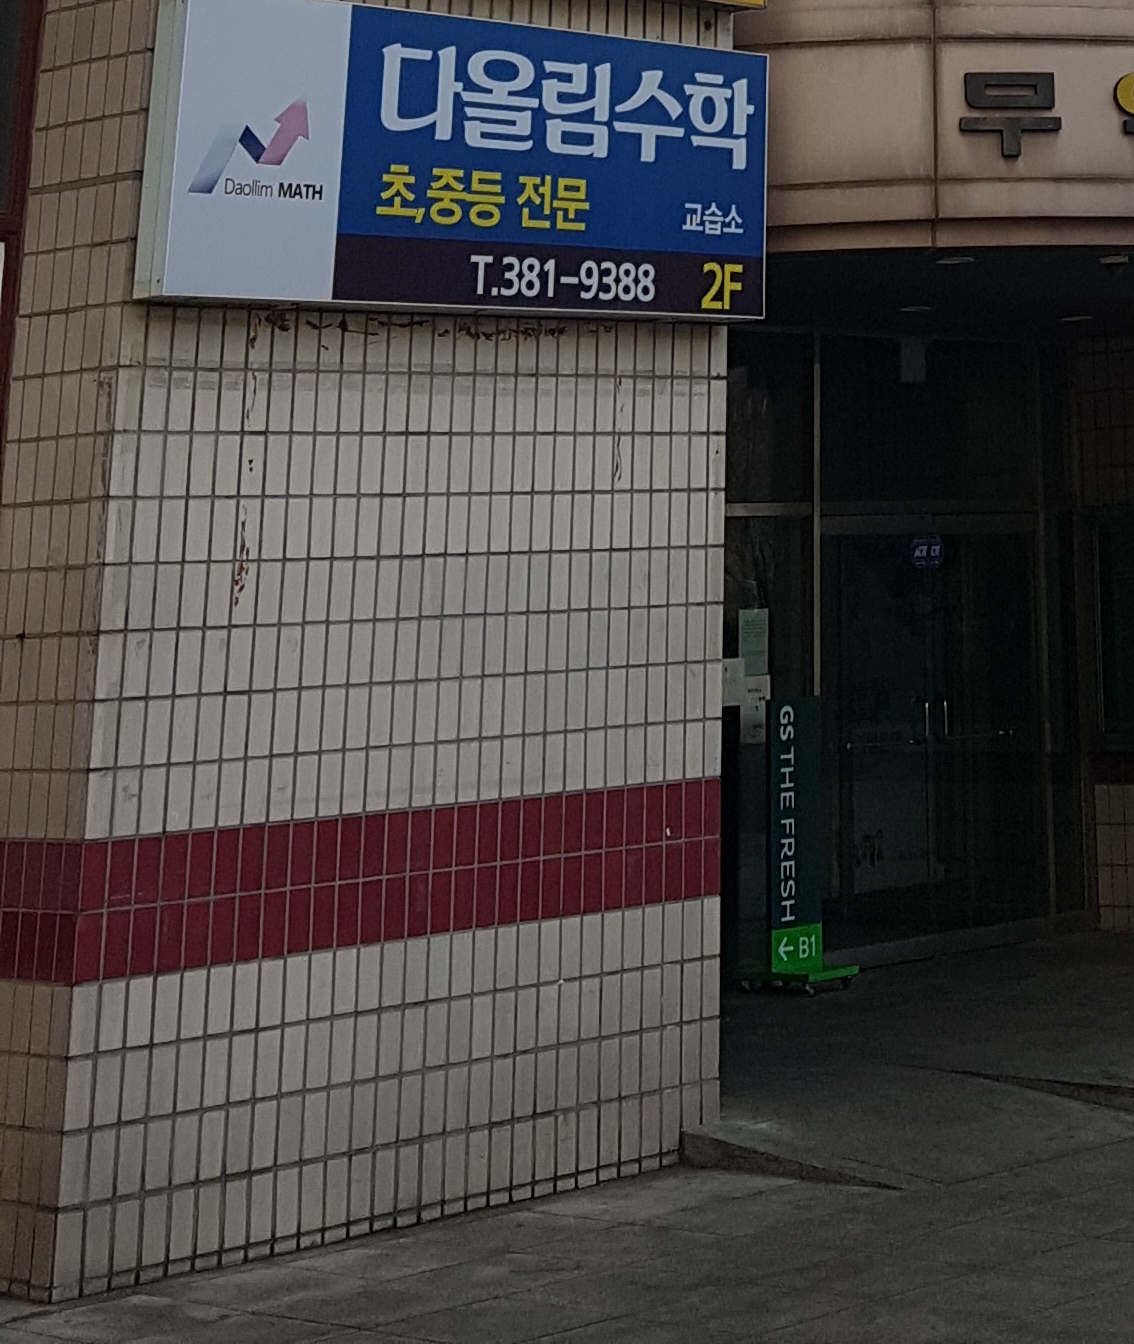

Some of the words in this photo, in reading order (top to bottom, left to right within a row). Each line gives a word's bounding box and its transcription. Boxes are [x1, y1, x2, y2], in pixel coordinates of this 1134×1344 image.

[381, 44, 755, 171] 다올림수학
[278, 181, 324, 202] MATH
[516, 173, 590, 232] 전문
[682, 202, 744, 236] 교습소
[470, 255, 656, 302] T.381-9388
[701, 263, 744, 310] 2F
[780, 704, 795, 739] GS
[780, 746, 796, 810] THE
[780, 815, 797, 922] FRESH
[800, 936, 817, 958] B1
